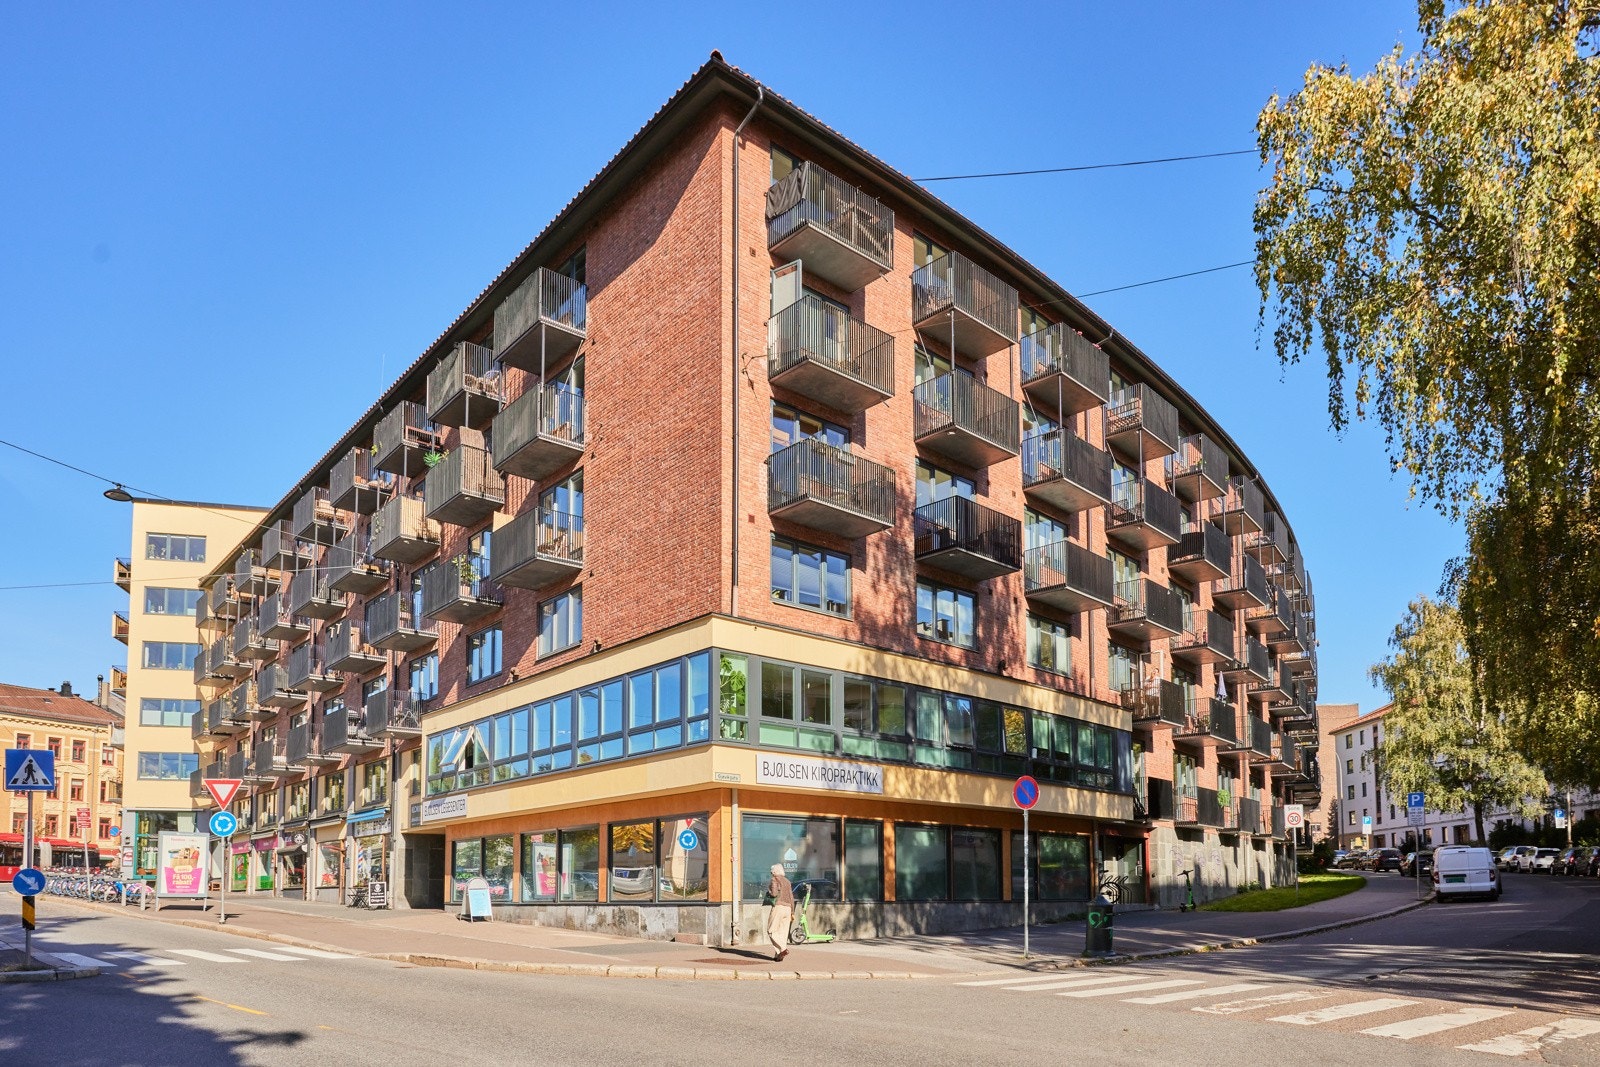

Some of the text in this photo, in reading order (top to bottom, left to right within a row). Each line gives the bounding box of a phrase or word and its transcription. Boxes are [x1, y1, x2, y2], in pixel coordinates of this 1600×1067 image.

[762, 761, 878, 787] BJØLSEN KIROPRAKTIKK
[1411, 794, 1420, 806] P
